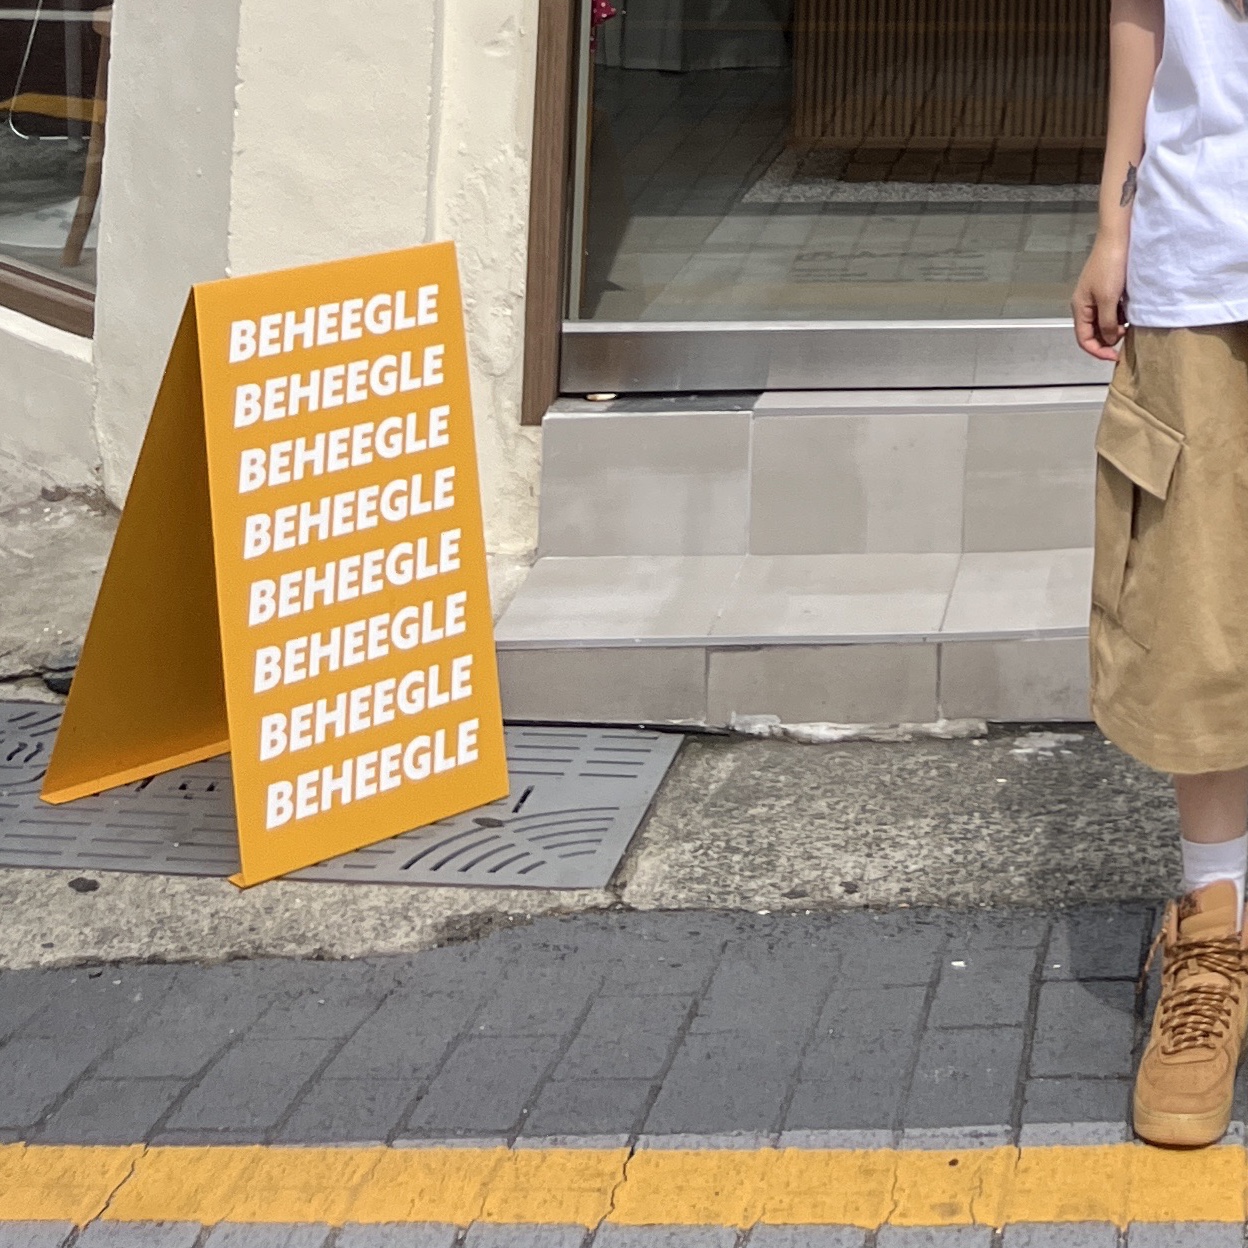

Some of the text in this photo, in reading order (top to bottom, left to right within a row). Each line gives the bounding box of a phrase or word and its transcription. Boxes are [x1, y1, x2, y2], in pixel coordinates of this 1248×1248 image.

[228, 284, 439, 364] BEHEEGLE
[233, 344, 445, 429] BEHEEGLE
[238, 405, 450, 494] BEHEEGLE
[243, 466, 455, 560] BEHEEGLE
[248, 528, 461, 627] BEHEEGLE
[253, 591, 467, 694] BEHEEGLE
[259, 654, 473, 762] BEHEEGLE
[265, 718, 479, 830] BEHEEGLE
